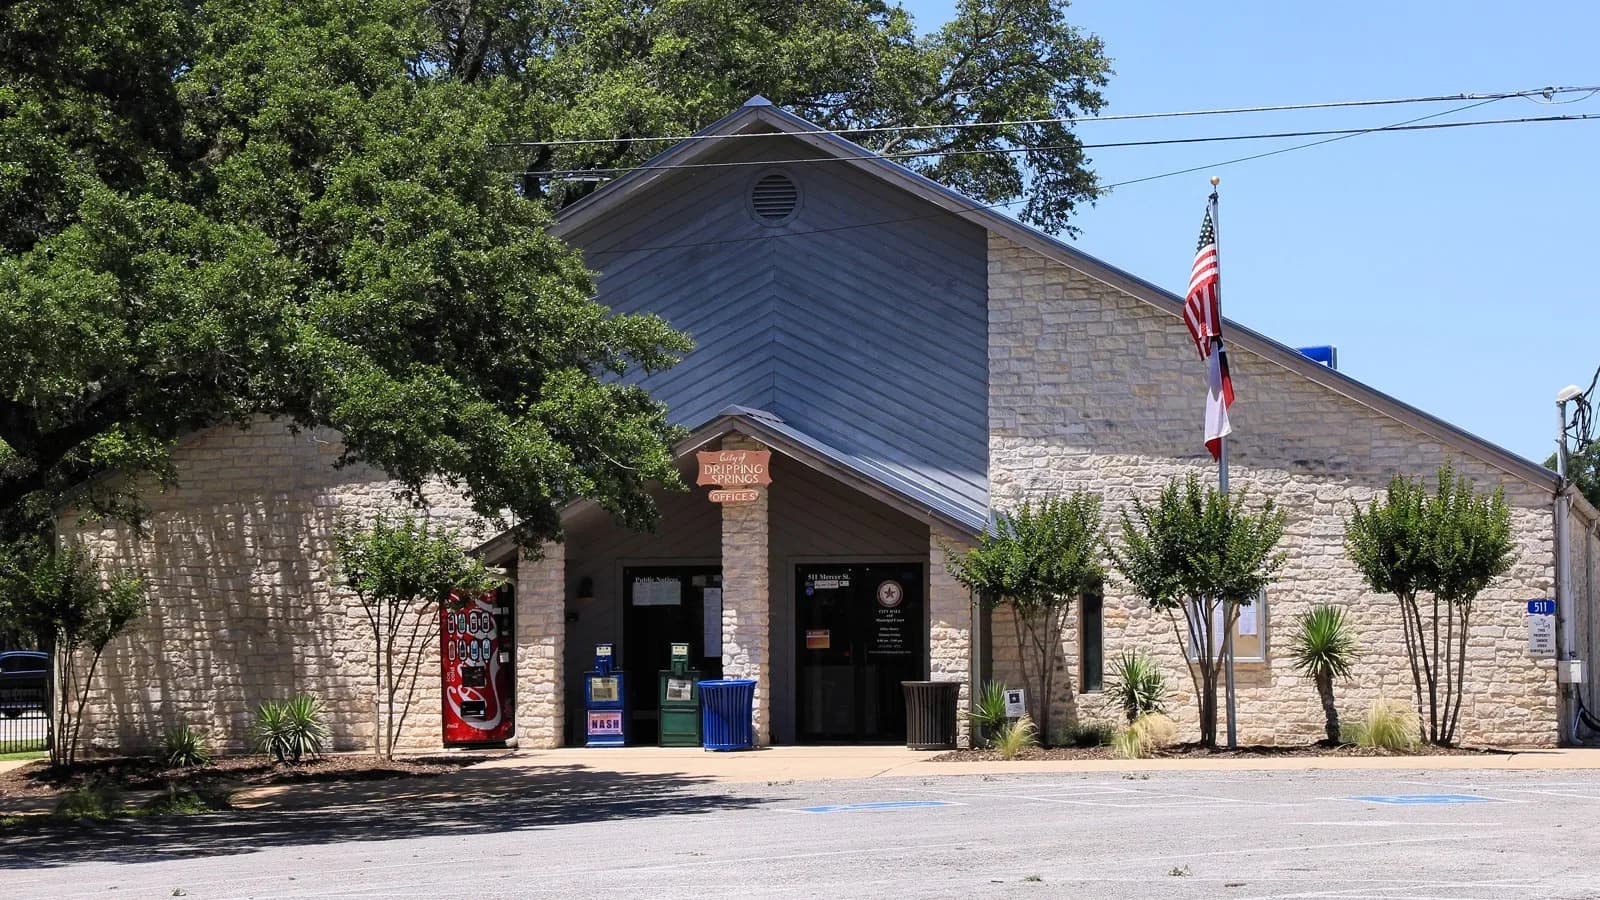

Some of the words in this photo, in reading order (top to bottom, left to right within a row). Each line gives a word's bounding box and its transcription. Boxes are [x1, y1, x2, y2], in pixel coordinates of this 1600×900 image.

[720, 453, 738, 464] City
[739, 452, 746, 464] of
[704, 464, 763, 475] DRIPPING
[711, 474, 759, 484] SPRINGS
[712, 493, 755, 501] OFFICES
[635, 576, 654, 585] Public
[1534, 602, 1547, 612] 511
[592, 719, 619, 729] NASH
